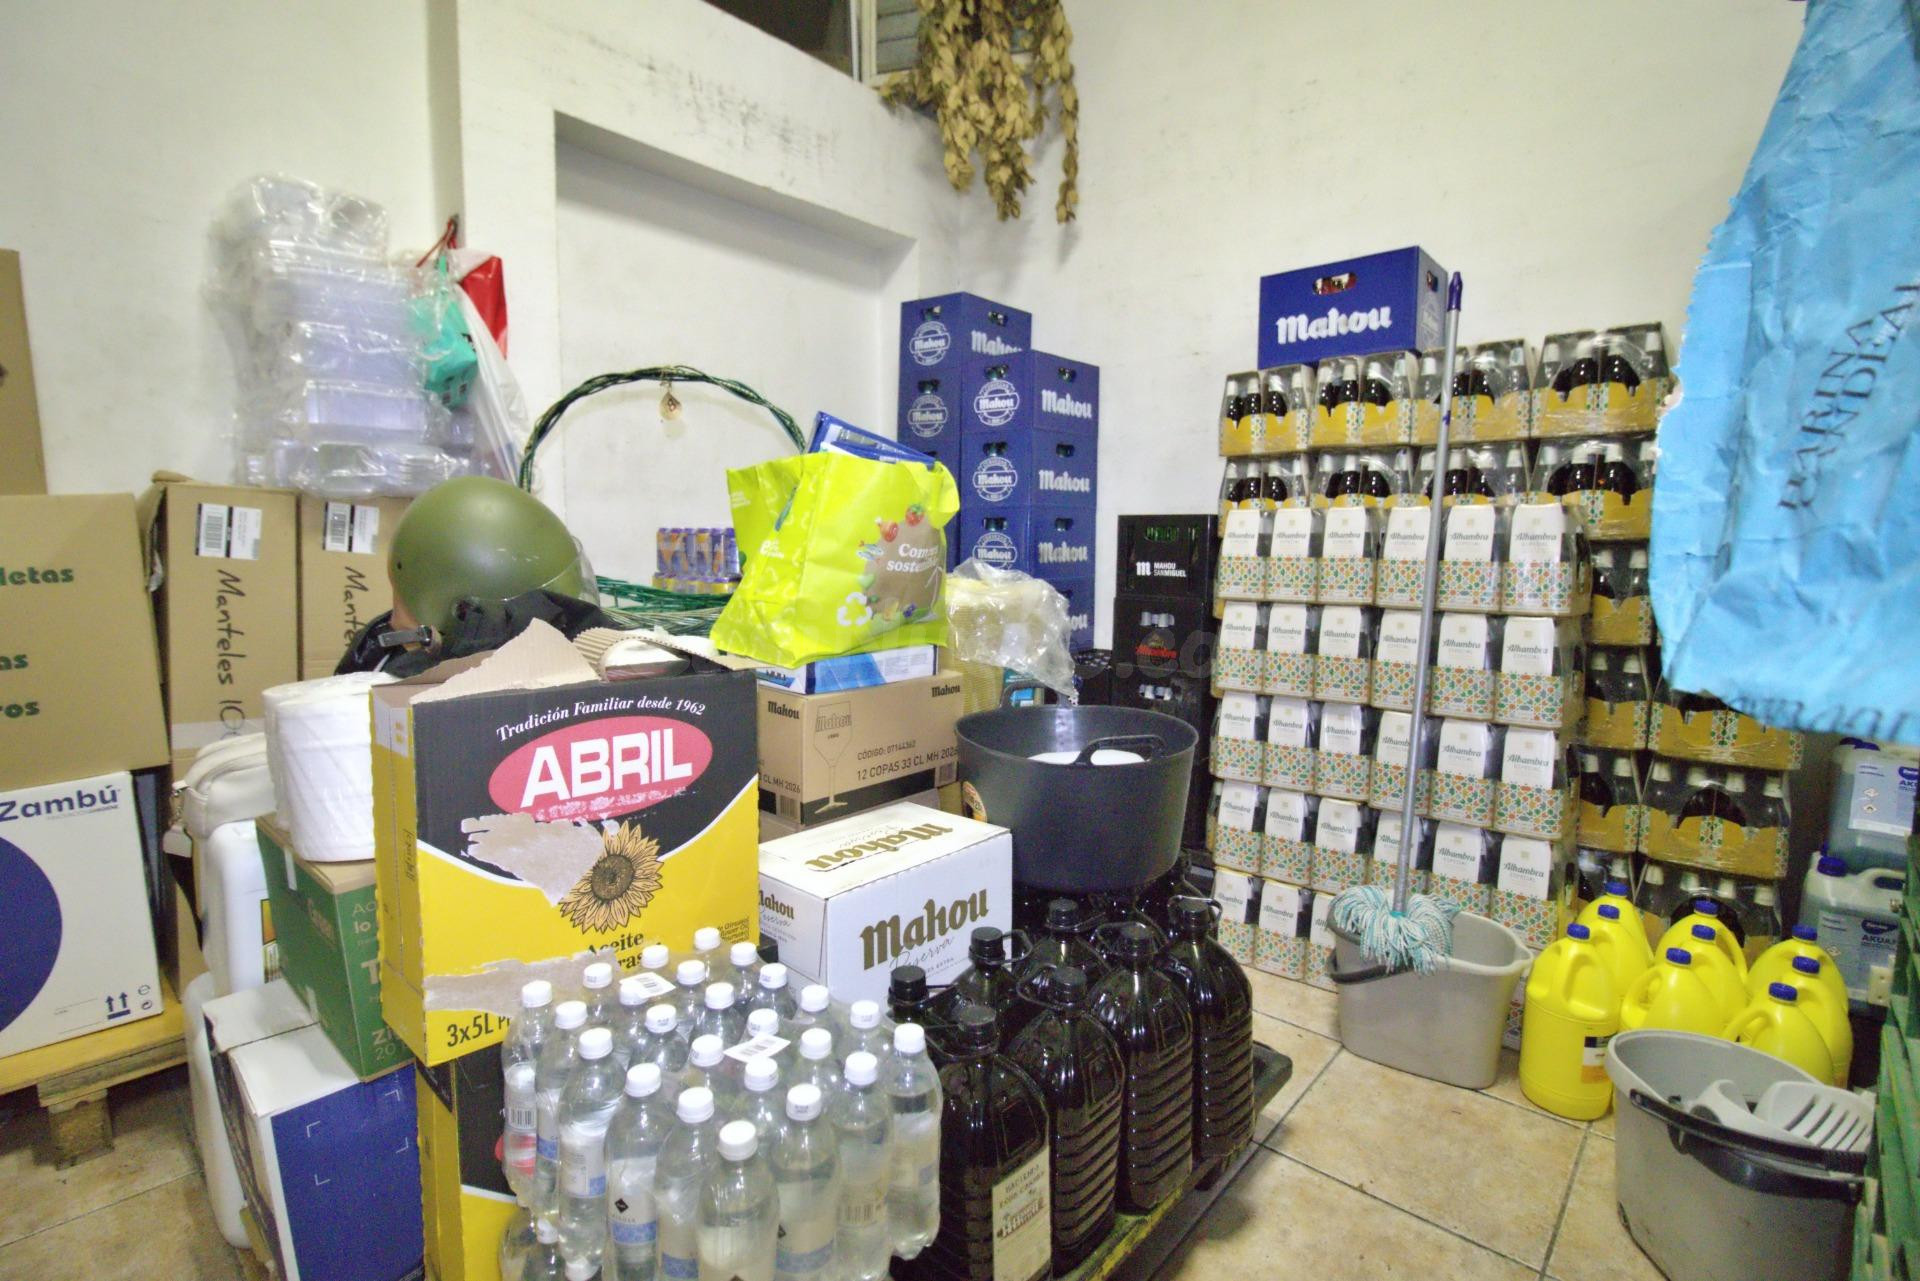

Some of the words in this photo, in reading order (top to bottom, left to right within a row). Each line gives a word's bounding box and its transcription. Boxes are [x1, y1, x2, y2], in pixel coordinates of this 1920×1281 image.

[1276, 306, 1391, 344] Mahou
[914, 337, 946, 351] Mahou
[971, 329, 1023, 356] Maho
[979, 397, 1014, 411] Mahou
[1041, 389, 1092, 419] Mahou
[912, 410, 942, 423] Mahou
[977, 473, 1012, 485] Mahou
[1038, 469, 1090, 493] Mahou
[1276, 531, 1306, 540] Alhambra
[1327, 531, 1361, 540] Alhambra
[1388, 531, 1425, 542] Alhambra
[1450, 532, 1489, 541] Alhambra
[1516, 532, 1557, 542] Alhambra
[977, 548, 1012, 560] Mahou
[1037, 541, 1088, 564] Mahou
[1154, 562, 1176, 570] MAHOU
[215, 569, 246, 686] Manteles
[1272, 626, 1302, 636] Alhambra
[1323, 630, 1356, 639] Alhambra
[1383, 634, 1417, 645] Alhambra
[1442, 638, 1481, 649] Alhambra
[1507, 644, 1549, 655] Alhambra
[931, 678, 961, 698] Mahou
[767, 700, 800, 720] Mahou
[496, 707, 570, 742] Tradición
[574, 698, 634, 717] Familiar
[637, 695, 673, 711] desde
[675, 698, 707, 717] 1962
[1273, 719, 1303, 730] Alhambra
[857, 747, 886, 761] CÓDIGO:
[1442, 743, 1482, 758] Alhambra
[857, 769, 868, 781] 12
[869, 763, 899, 778] COPAS
[914, 755, 925, 767] CL
[927, 751, 939, 761] MH
[1507, 753, 1550, 767] Alhambra
[520, 728, 693, 808] ABRIL
[0, 784, 118, 822] Zambú
[1269, 810, 1300, 824] Alhambra
[804, 821, 953, 872] Mahou
[1438, 847, 1476, 863] Alhambra
[1503, 861, 1545, 879] Alhambra
[1263, 905, 1295, 919] Alhambra
[860, 889, 989, 971] Mahou
[446, 1013, 494, 1047] 3x5L
